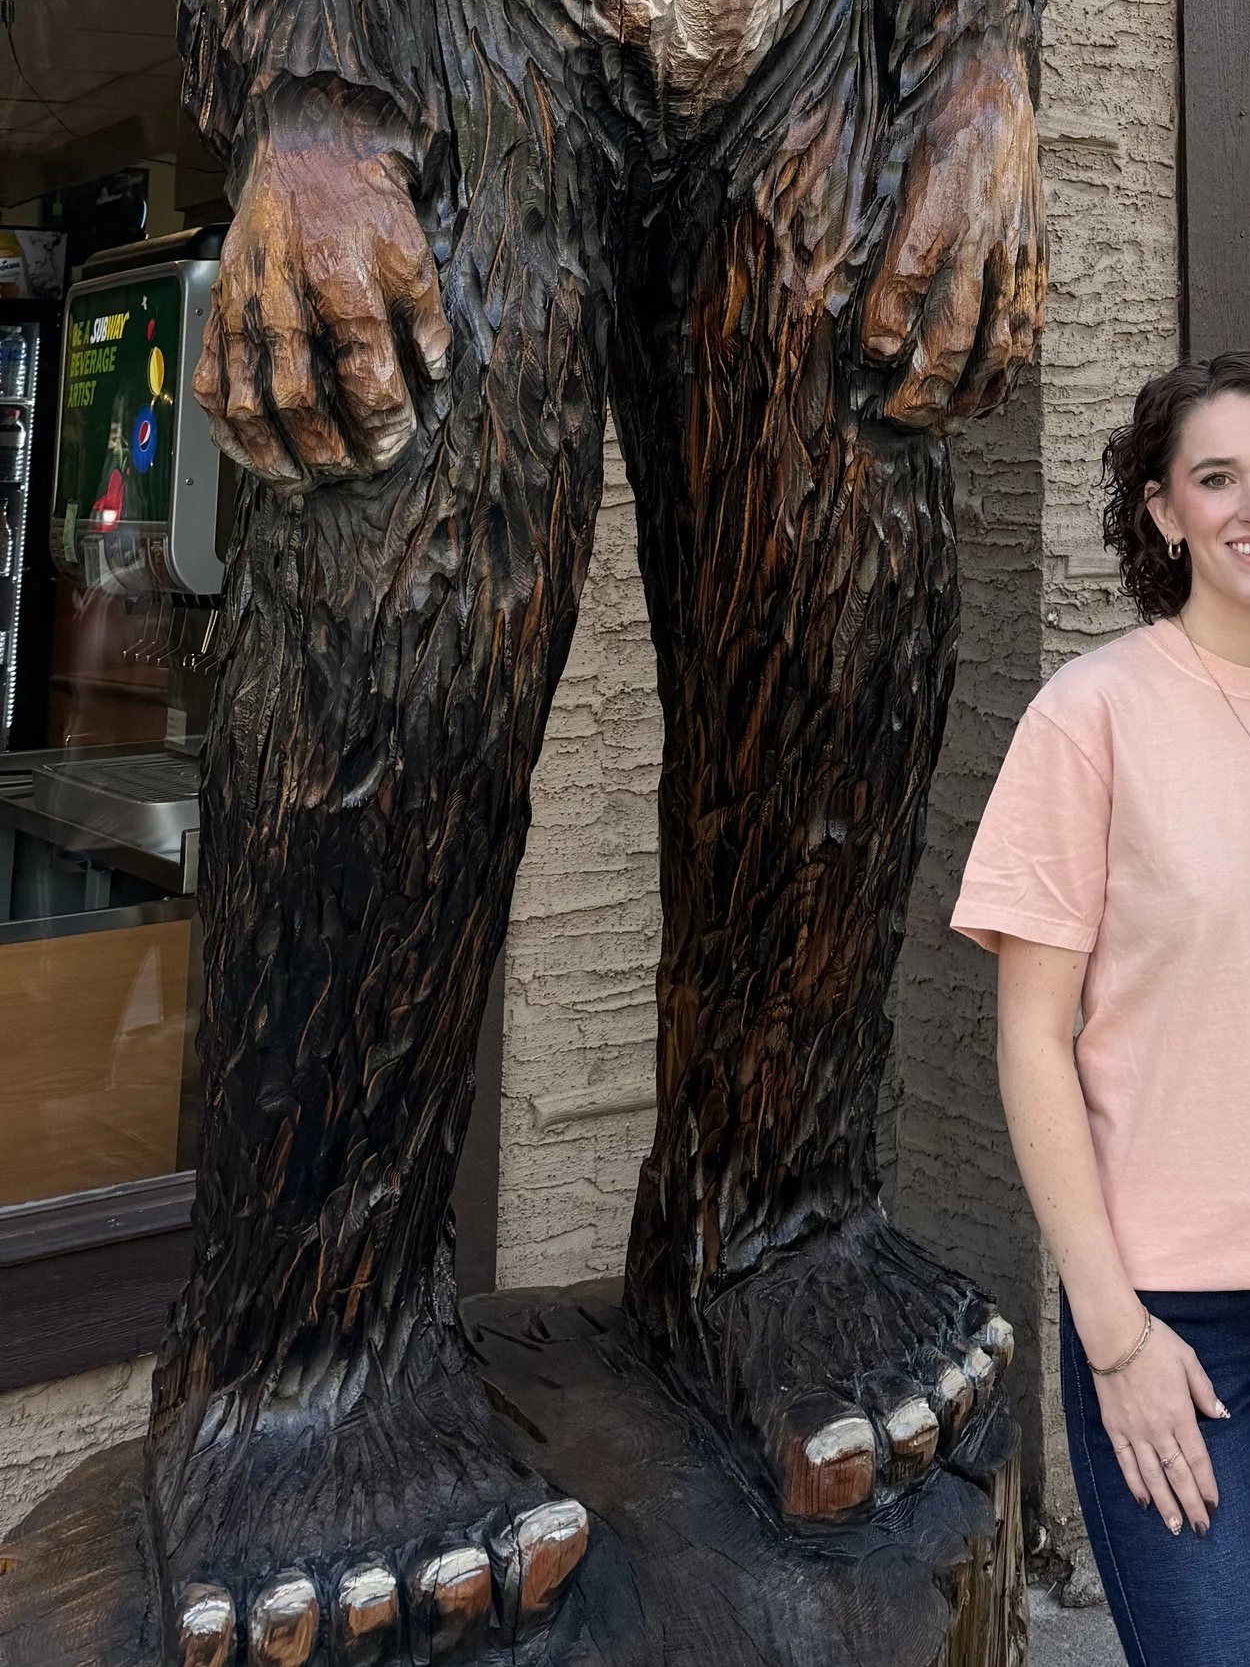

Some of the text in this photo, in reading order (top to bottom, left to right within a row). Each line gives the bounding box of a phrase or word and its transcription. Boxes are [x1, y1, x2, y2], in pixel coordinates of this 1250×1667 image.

[72, 311, 130, 347] BE A SUBWAY
[70, 346, 117, 377] BEVERAGE
[67, 381, 96, 408] ARTIST
